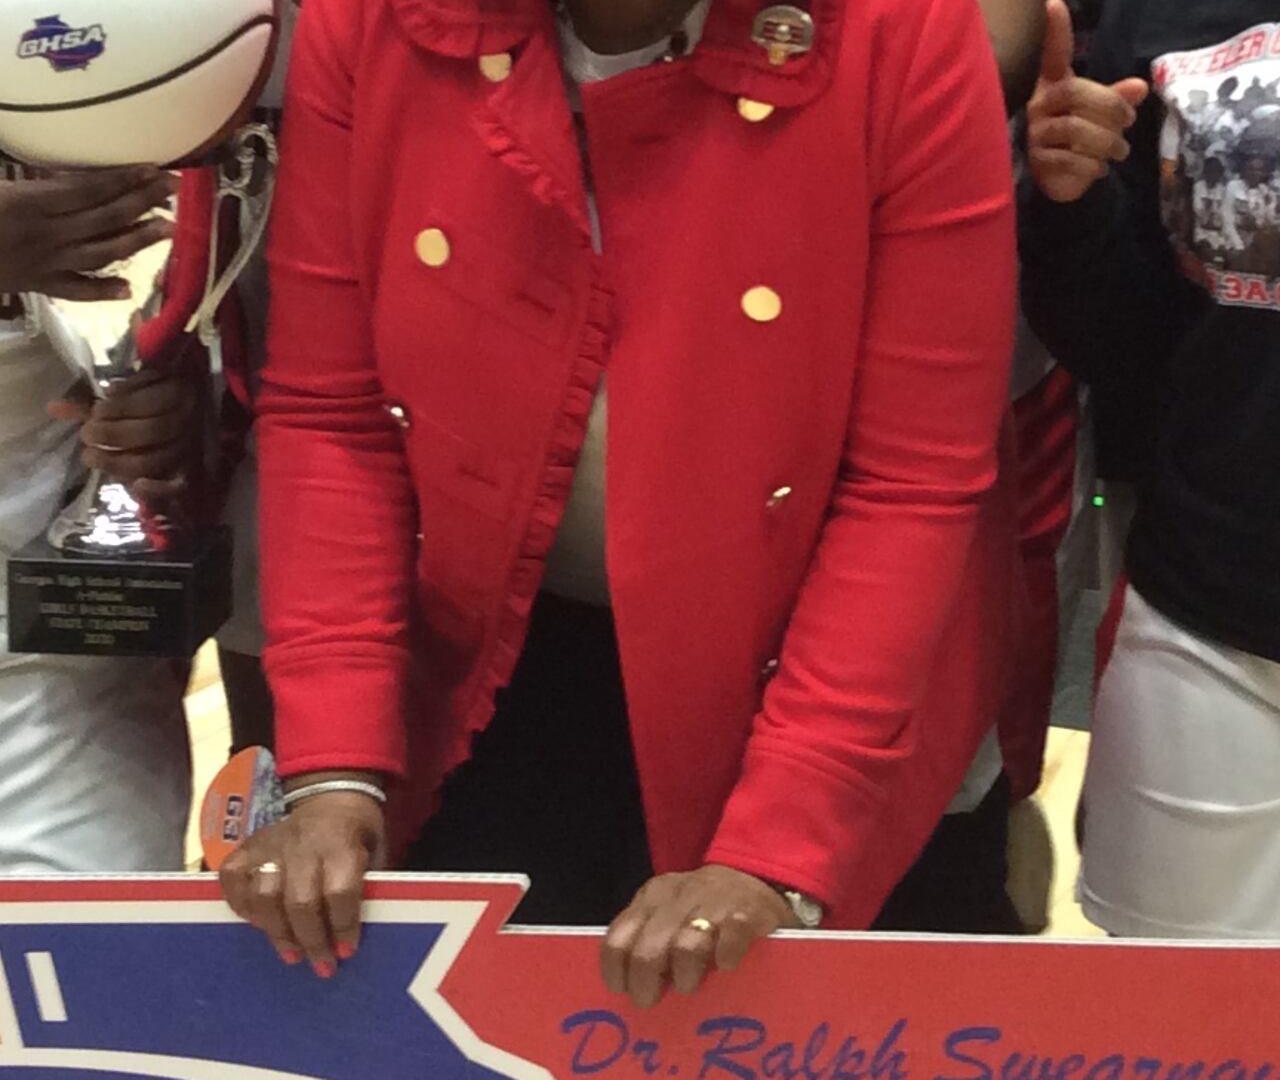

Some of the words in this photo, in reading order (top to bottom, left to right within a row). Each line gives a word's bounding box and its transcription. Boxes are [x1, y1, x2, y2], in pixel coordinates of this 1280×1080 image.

[20, 24, 105, 57] GHSA
[559, 1009, 680, 1075] Dr.
[695, 1015, 910, 1080] Ralph
